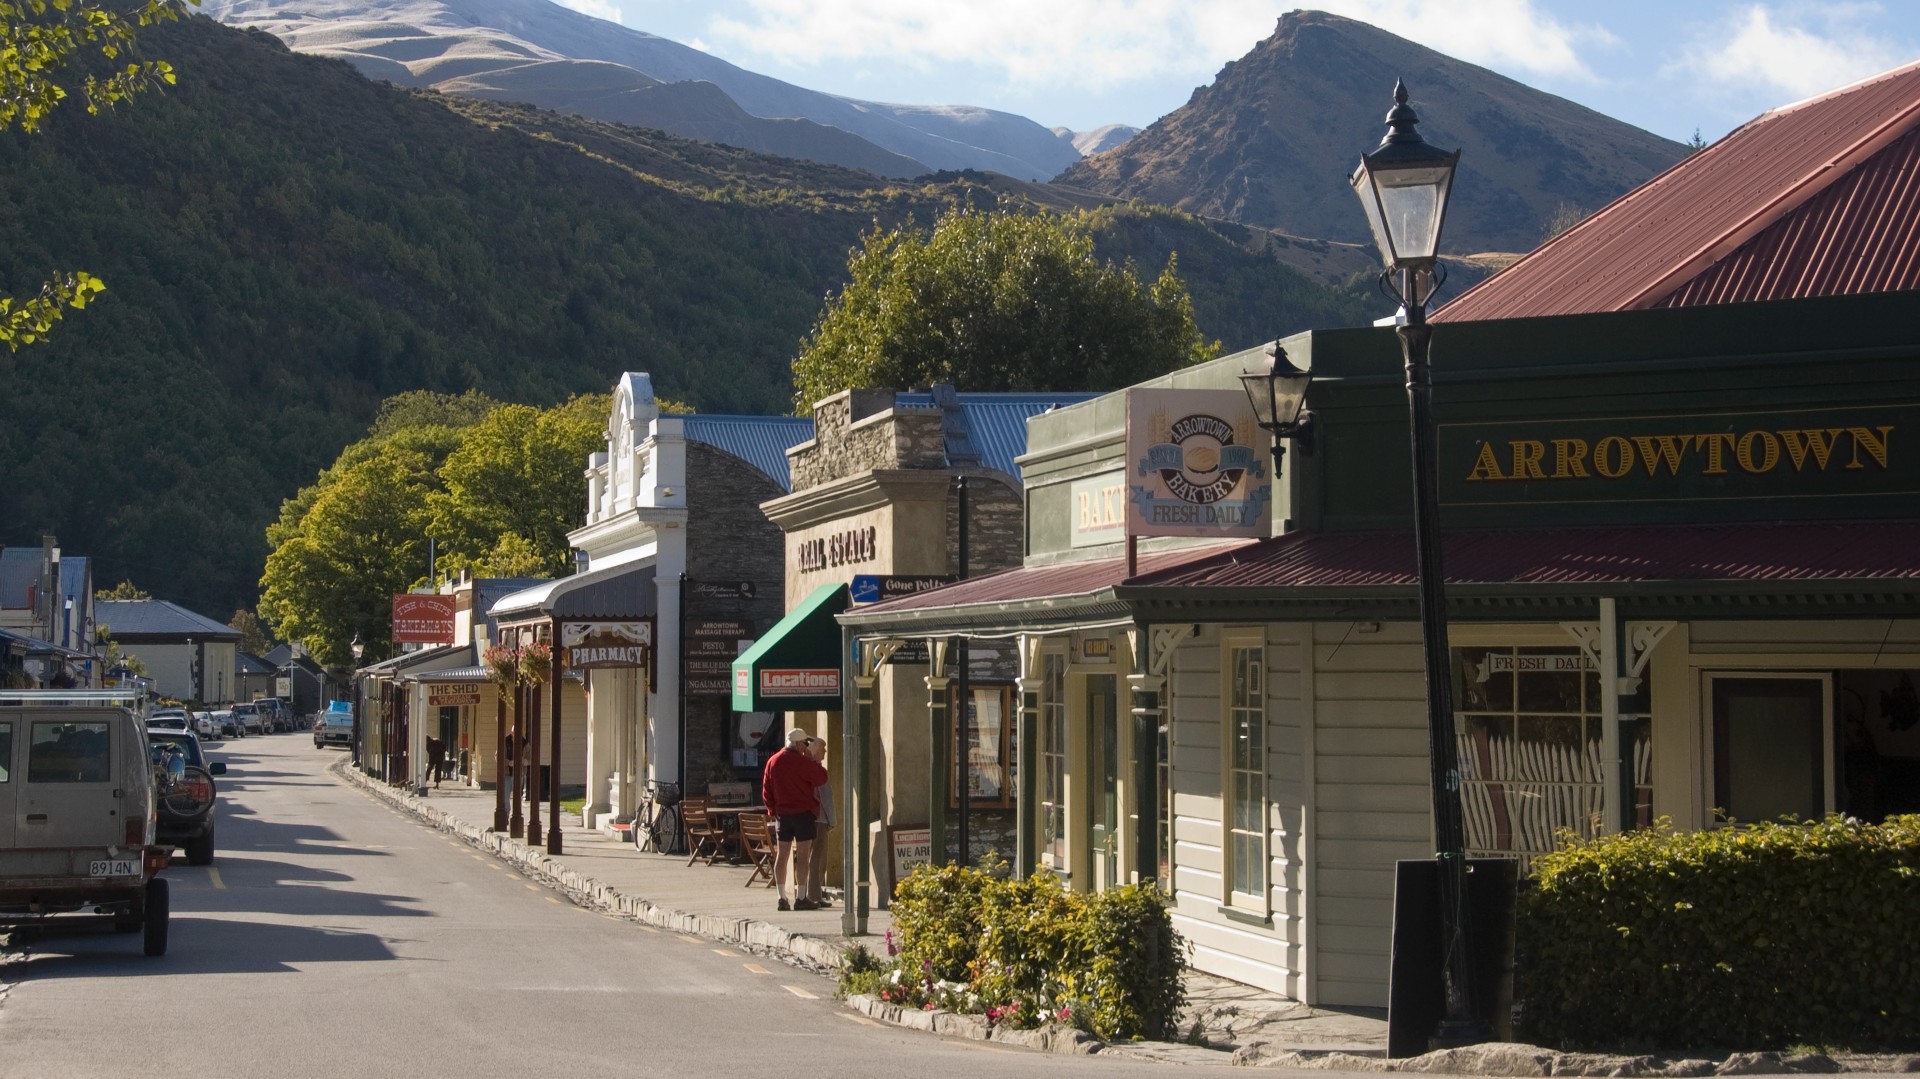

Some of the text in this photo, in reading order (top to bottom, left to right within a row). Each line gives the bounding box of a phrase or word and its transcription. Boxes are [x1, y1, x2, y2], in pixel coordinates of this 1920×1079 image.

[1171, 417, 1234, 443] ARROWTOWN
[1228, 448, 1248, 462] 1990
[1466, 426, 1895, 481] ARROWTOWN
[1167, 472, 1236, 502] BAKERY
[1153, 505, 1249, 524] FRESH DAILY
[798, 526, 875, 574] REAL ESTATE
[885, 580, 913, 590] Gone
[397, 601, 417, 616] FISH
[428, 601, 452, 616] CHIPS
[394, 619, 454, 634] TAKEAWAYS
[702, 641, 725, 650] PESTO
[572, 647, 643, 667] PHARMACY
[1495, 657, 1595, 670] FRESH DAIL
[689, 661, 701, 669] THE
[701, 661, 721, 669] BLUE
[689, 680, 733, 689] NGAUMATA
[763, 672, 838, 687] Locations
[430, 684, 479, 695] THE SHED
[896, 847, 911, 857] WE
[91, 862, 131, 875] 8914N
